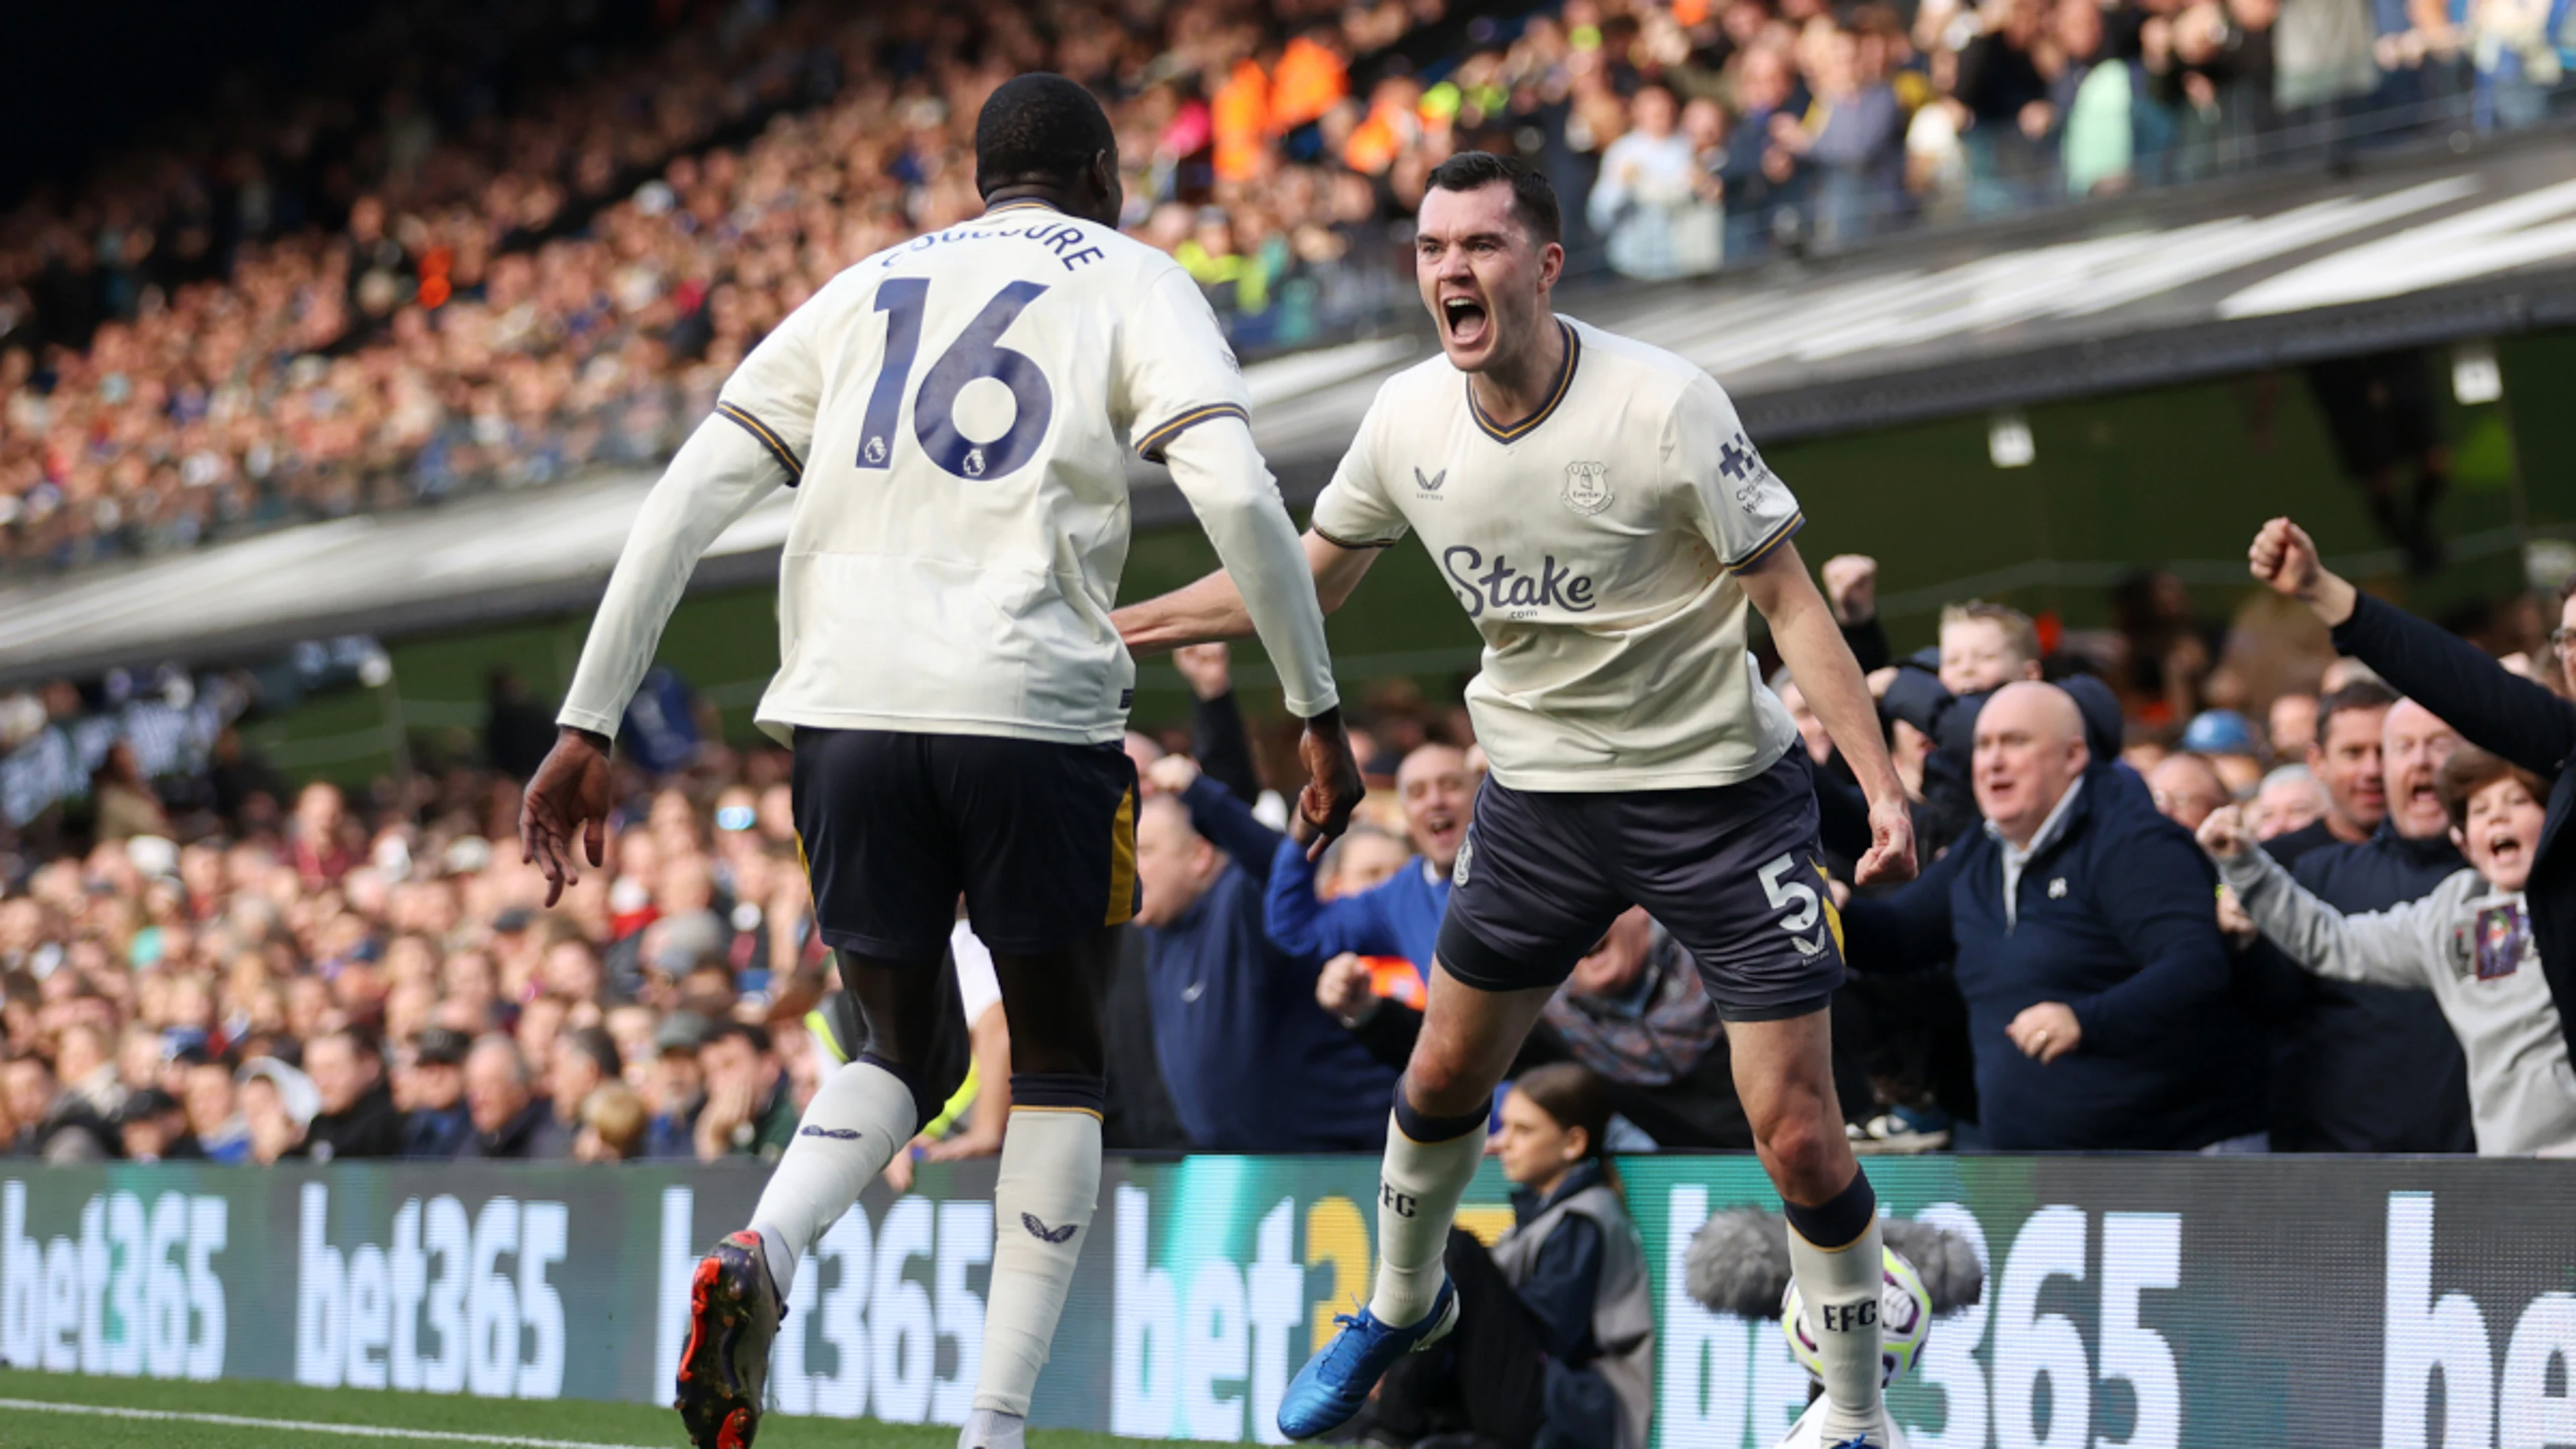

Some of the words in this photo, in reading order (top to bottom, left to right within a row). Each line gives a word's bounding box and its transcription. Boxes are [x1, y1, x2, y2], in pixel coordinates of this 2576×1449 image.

[855, 277, 1053, 481] 16
[1444, 545, 1596, 618] Stake
[1758, 852, 1819, 931] 5
[2, 1179, 228, 1381] bet365
[296, 1181, 568, 1399] bet365
[1379, 1181, 1416, 1218] FC
[654, 1186, 997, 1427] bt365
[1659, 1185, 2181, 1449] be365
[1823, 1299, 1877, 1332] EFC
